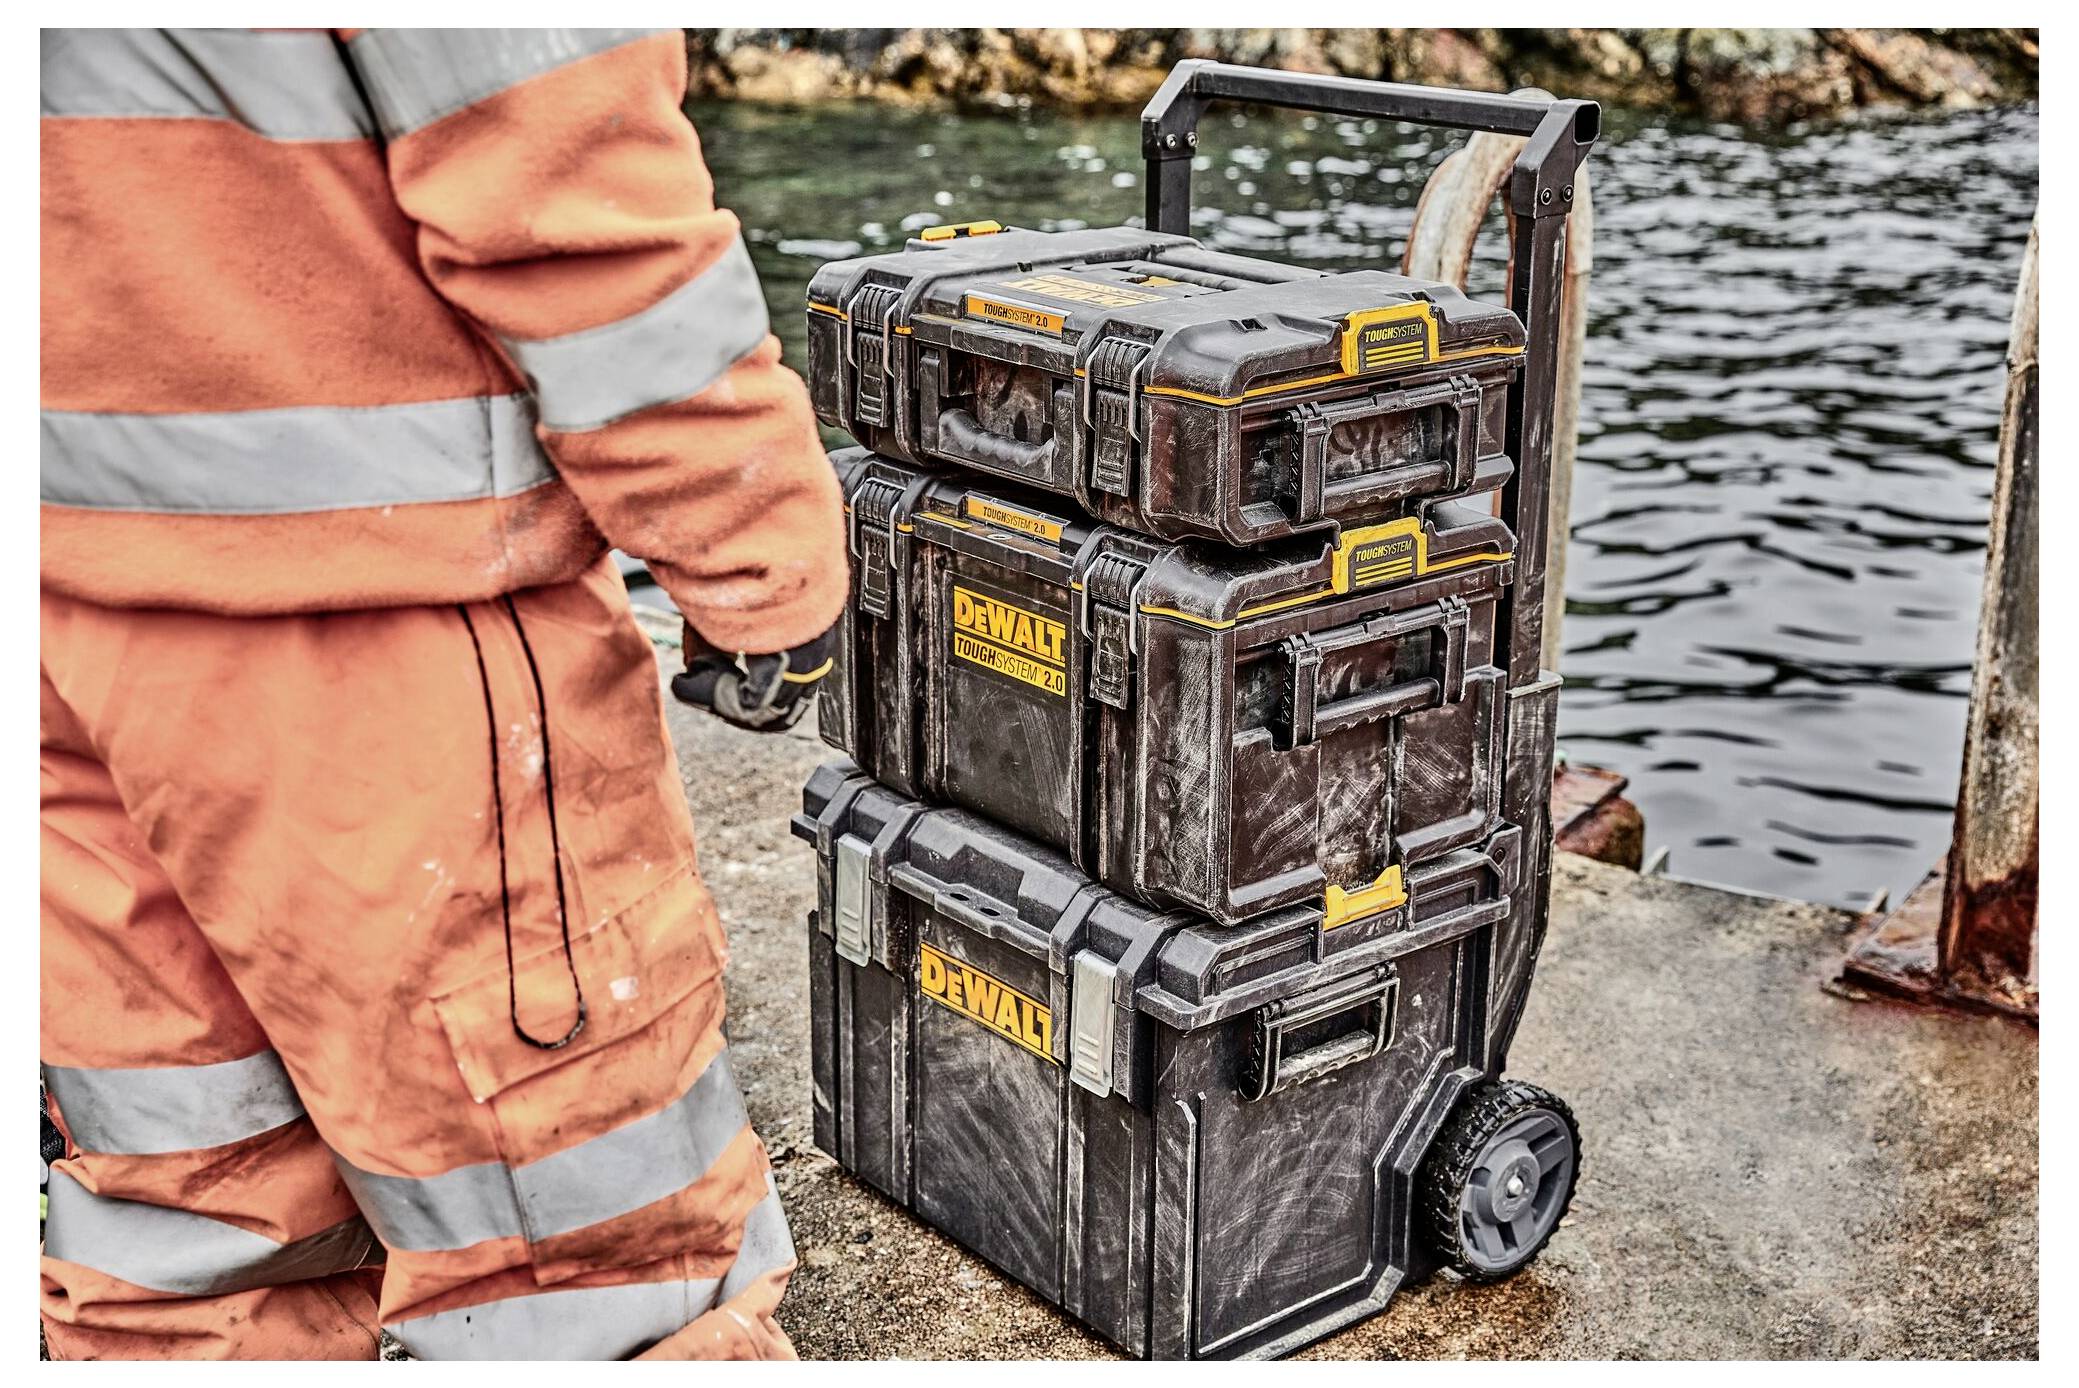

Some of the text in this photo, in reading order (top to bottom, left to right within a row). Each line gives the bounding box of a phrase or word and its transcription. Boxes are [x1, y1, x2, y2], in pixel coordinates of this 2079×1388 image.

[984, 303, 1048, 328] TOUGHSYSTEM 2.0
[1365, 322, 1423, 343] TOUGHSYSTEM
[983, 506, 1046, 535] TOUGHSYSTEM 2.0
[1355, 539, 1413, 563] TOUGHSYSTEM
[957, 637, 1063, 692] TOUGHSYSTEM 2.0
